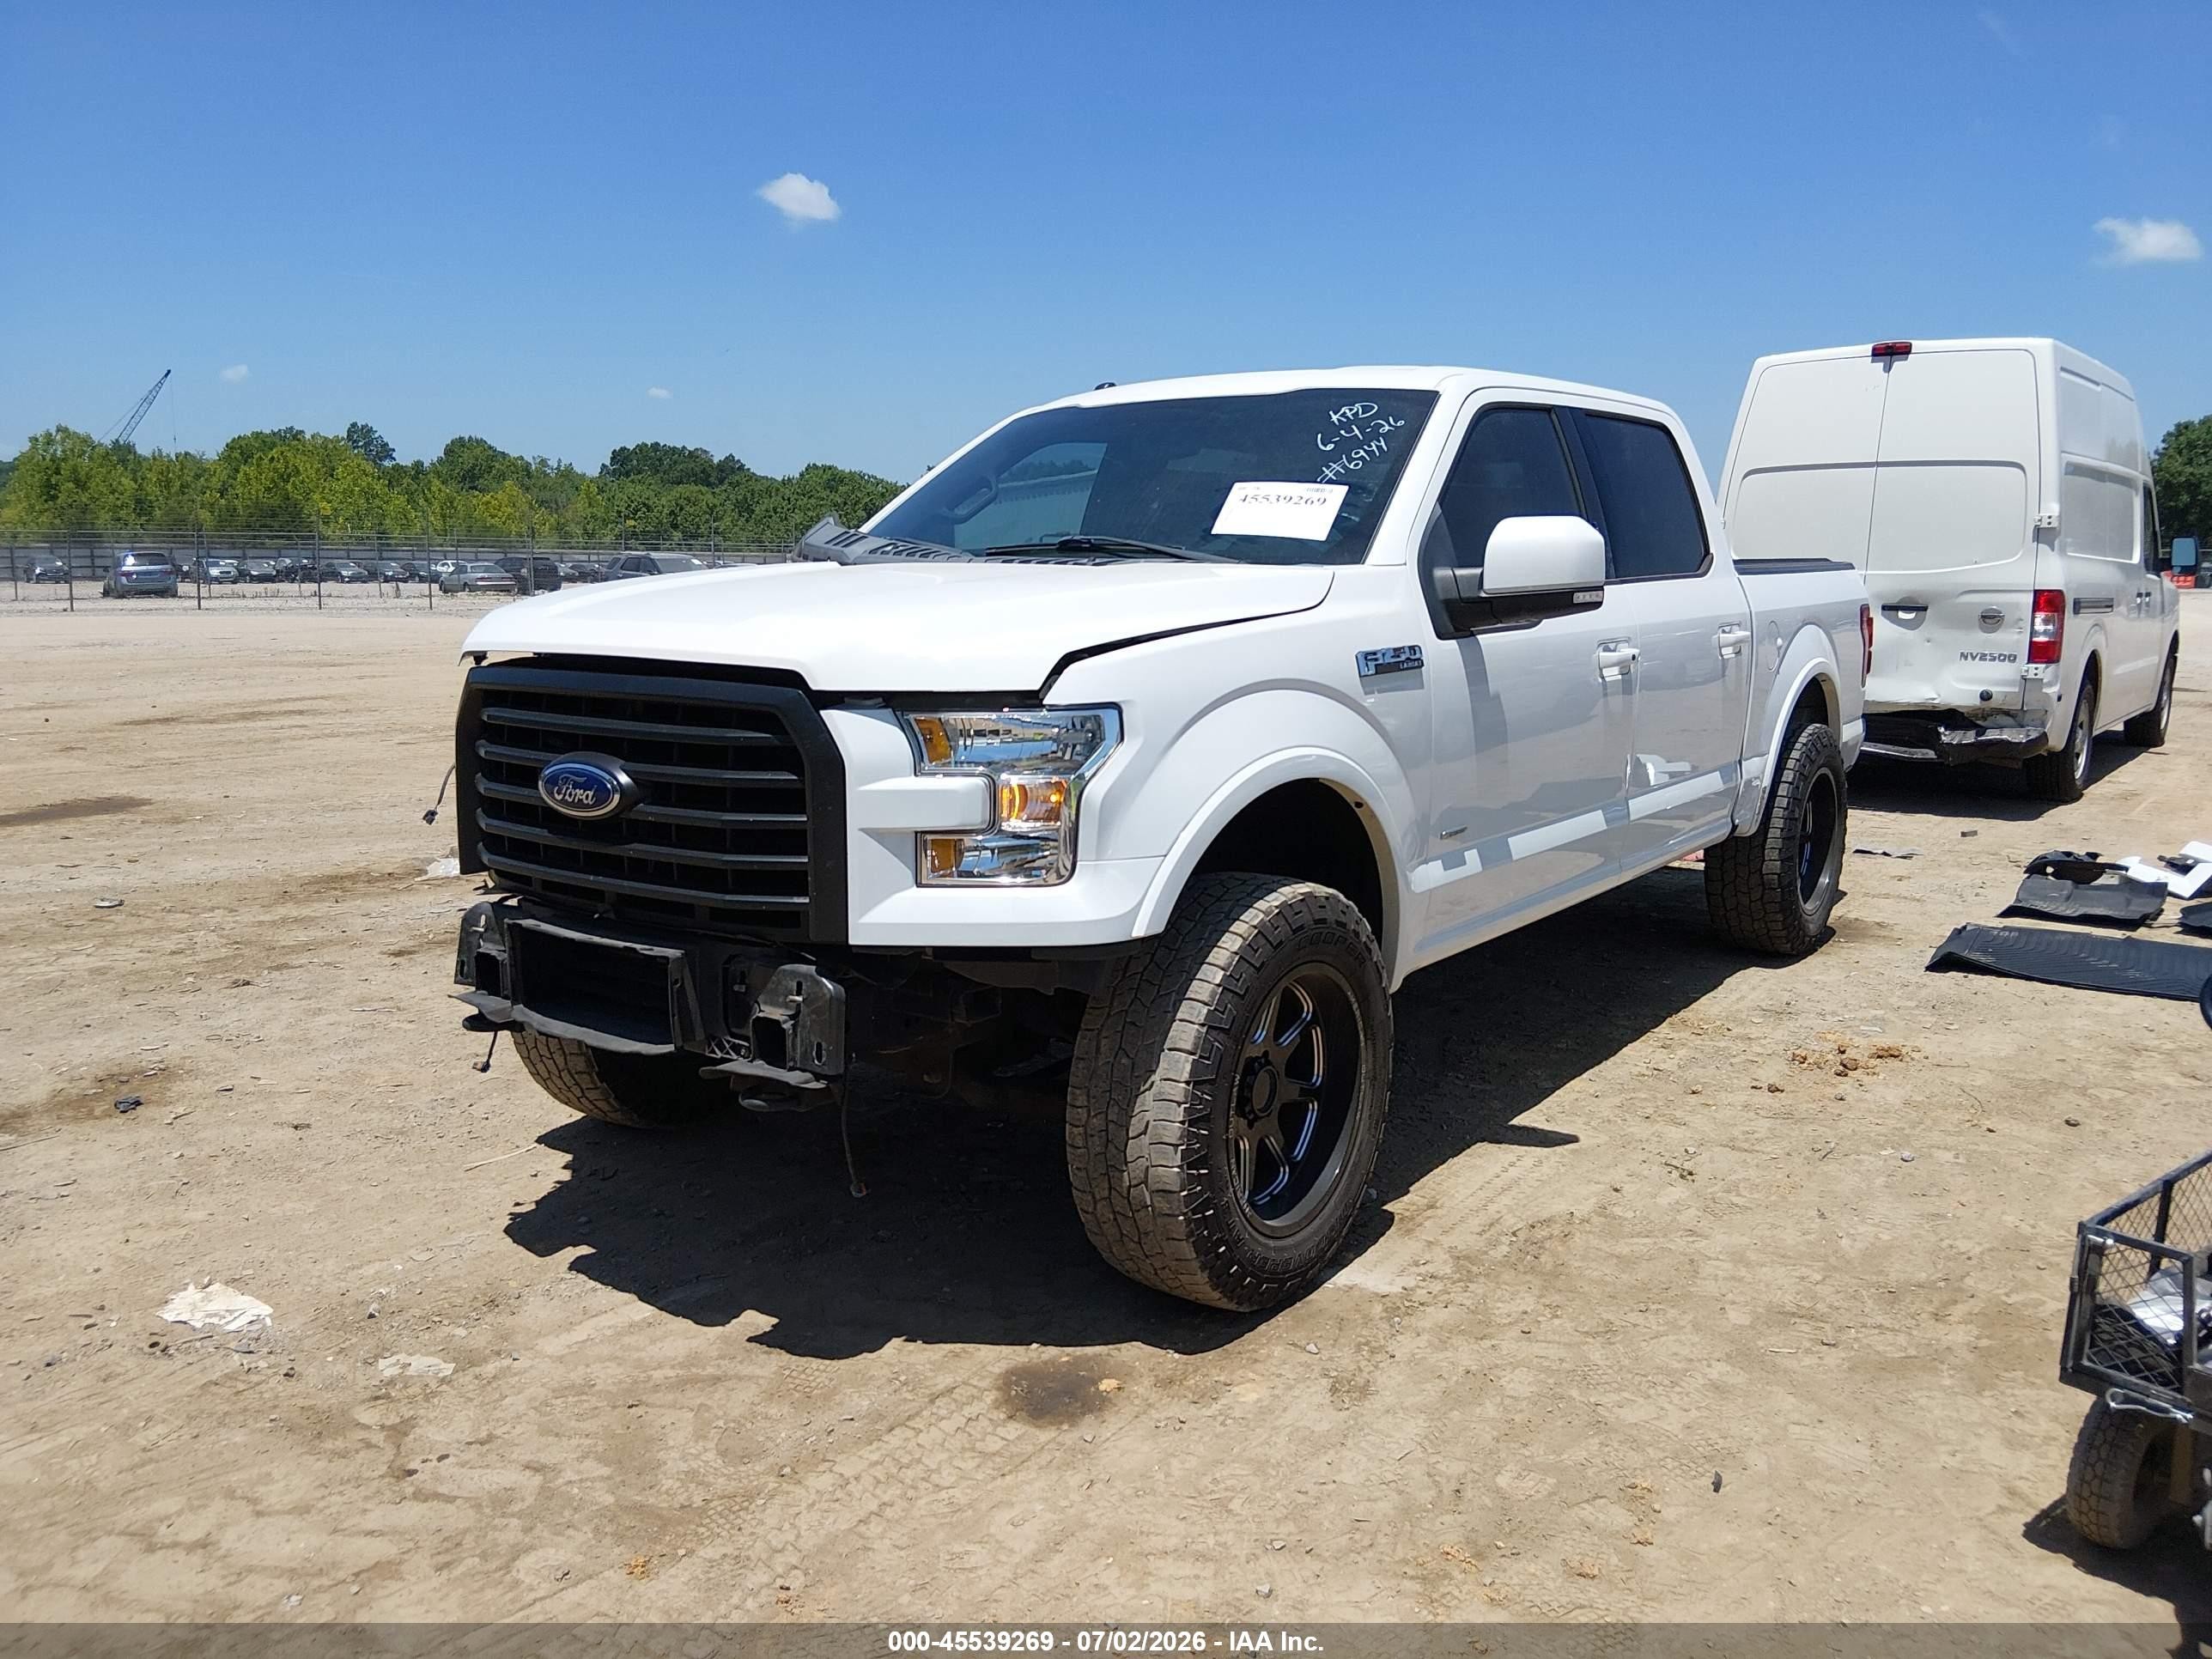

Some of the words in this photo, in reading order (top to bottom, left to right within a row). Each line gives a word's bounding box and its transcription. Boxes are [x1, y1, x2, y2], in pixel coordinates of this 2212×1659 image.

[1328, 402, 1379, 425] KPD
[1316, 416, 1406, 452] 6-4-26
[1239, 494, 1328, 506] 45539269
[1959, 652, 2018, 664] NV2500
[553, 774, 599, 805] Ford
